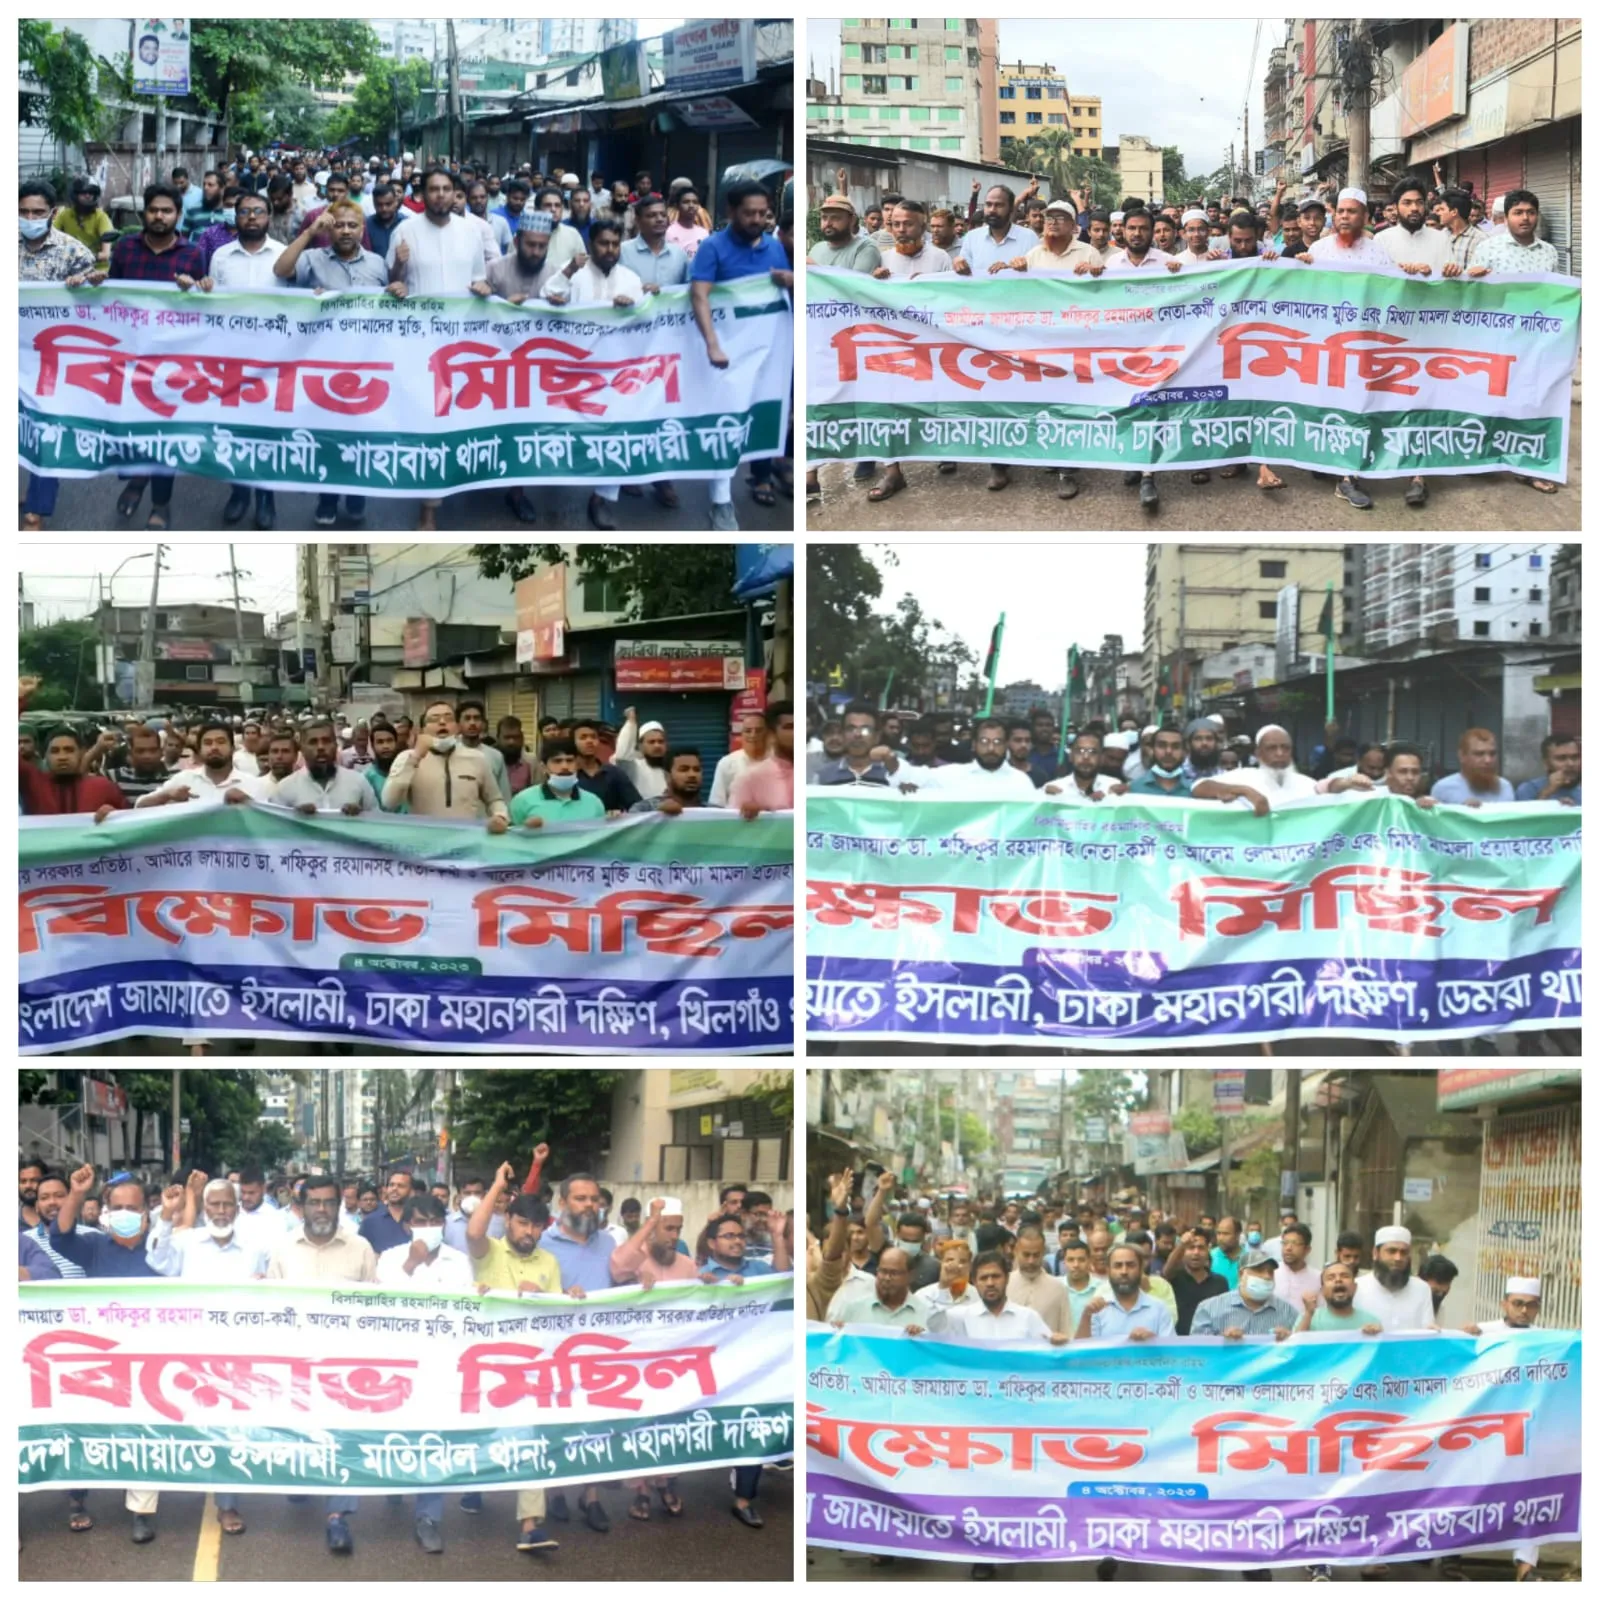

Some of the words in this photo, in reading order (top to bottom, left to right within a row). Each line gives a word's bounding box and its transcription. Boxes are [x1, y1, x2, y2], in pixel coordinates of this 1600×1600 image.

[75, 303, 96, 321] ডা.
[103, 300, 150, 329] শফিকুর
[156, 309, 200, 328] রহমান
[205, 312, 224, 327] সহ
[228, 312, 292, 337] নেতা-কর্মী,
[297, 317, 334, 335] আলেম
[338, 316, 394, 336] ওলামাদের
[1158, 296, 1215, 321] নেতা-কর্মী
[1218, 302, 1228, 317] ও
[1231, 299, 1267, 317] আলেম
[1272, 301, 1329, 320] ওলামাদের
[1333, 300, 1358, 326] মুক্তি
[1362, 305, 1381, 324] এবং
[1386, 304, 1414, 326] মিথ্যা
[1418, 309, 1450, 325] মামলা
[1451, 310, 1516, 330] প্রত্যাহারের
[1520, 311, 1563, 333] দাবিতে
[33, 324, 394, 418] বিক্ষোভ
[428, 337, 681, 417] মিছিল
[830, 323, 1186, 391] বিক্ষোভ
[1217, 322, 1516, 397] মিছিল
[1191, 389, 1224, 400] ২০২৩
[72, 424, 206, 467] জামায়াতে
[212, 425, 328, 482] ইসলামী,
[338, 440, 450, 486] শাহাবাগ
[456, 435, 507, 476] থানা,
[513, 431, 576, 470] ঢাকা
[581, 417, 691, 472] মহানগরী
[806, 416, 911, 453] বাংলাদেশ
[917, 417, 1030, 449] জামায়াতে
[1035, 410, 1124, 454] ইসলামী,
[1131, 414, 1183, 452] ঢাকা
[1188, 406, 1297, 450] মহানগরী
[1303, 412, 1376, 463] দক্ষিণ,
[1381, 418, 1486, 460] যাত্রাবাড়ী
[1491, 430, 1546, 459] থানা
[36, 864, 83, 881] সরকার
[144, 847, 193, 868] আমীরে
[198, 849, 251, 868] জামায়াত
[255, 853, 276, 873] ডা.
[280, 849, 328, 878] শফিকুর
[332, 855, 393, 878] রহমানসহ
[599, 860, 631, 888] মুক্তি
[635, 866, 664, 885] এবং
[668, 860, 704, 885] মিথ্যা
[905, 837, 932, 857] ডা.
[1164, 843, 1177, 860] ও
[18, 884, 430, 954] বিক্ষোভ
[1170, 864, 1568, 940] মিছিল
[117, 980, 234, 1018] জামায়াতে
[240, 976, 356, 1029] ইসলামী,
[365, 991, 431, 1029] ঢাকা
[438, 983, 568, 1034] মহানগরী
[575, 985, 670, 1040] দক্ষিণ,
[677, 985, 781, 1034] খিলগাঁও
[894, 971, 1044, 1030] ইসলামী,
[1057, 987, 1142, 1025] ঢাকা
[1152, 966, 1306, 1027] মহানগরী
[1314, 965, 1430, 1023] দক্ষিণ,
[1436, 973, 1532, 1018] ডেমরা
[67, 1306, 92, 1326] ডা.
[97, 1301, 151, 1328] শফিকুর
[157, 1307, 204, 1326] রহমান
[208, 1310, 229, 1327] সহ
[306, 1312, 351, 1330] আলেম
[356, 1315, 421, 1334] ওলামাদের
[462, 1315, 494, 1338] মিথ্যা
[590, 1307, 653, 1328] কেয়ারটেকার
[657, 1308, 698, 1324] সরকার
[452, 1297, 482, 1312] রহিম
[22, 1329, 419, 1422] বিক্ষোভ
[457, 1332, 718, 1413] মিছিল
[808, 1367, 857, 1394] প্রতিষ্ঠা,
[861, 1370, 907, 1396] আমীরে
[911, 1378, 968, 1397] জামায়াত
[972, 1379, 993, 1398] ডা.
[998, 1374, 1045, 1402] শফিকুর
[1051, 1380, 1111, 1400] রহমানসহ
[1116, 1375, 1182, 1400] নেতা-কর্মী
[1185, 1384, 1197, 1400] ও
[1201, 1383, 1245, 1402] আলেম
[1252, 1383, 1314, 1402] ওলামাদের
[1320, 1377, 1349, 1404] মুক্তি
[1353, 1384, 1378, 1400] এবং
[1382, 1375, 1408, 1398] মিথ্যা
[1412, 1377, 1447, 1396] মামলা
[1526, 1357, 1569, 1382] দাবিতে
[79, 1432, 219, 1474] জামায়াতে
[228, 1427, 350, 1484] ইসলামী,
[358, 1432, 481, 1480] মতিঝিল
[488, 1434, 557, 1475] থানা,
[621, 1408, 718, 1463] মহানগরী
[722, 1406, 793, 1451] দক্ষিণ
[1190, 1410, 1531, 1474] মিছিল
[1156, 1487, 1197, 1497] ২০২৩
[823, 1494, 956, 1540] জামায়াতে
[962, 1505, 1077, 1553] ইসলামী,
[1085, 1517, 1151, 1550] ঢাকা
[1158, 1505, 1286, 1552] মহানগরী
[1293, 1505, 1379, 1552] দক্ষিণ,
[1386, 1501, 1507, 1550] সবুজবাগ
[1513, 1493, 1564, 1526] থানা
